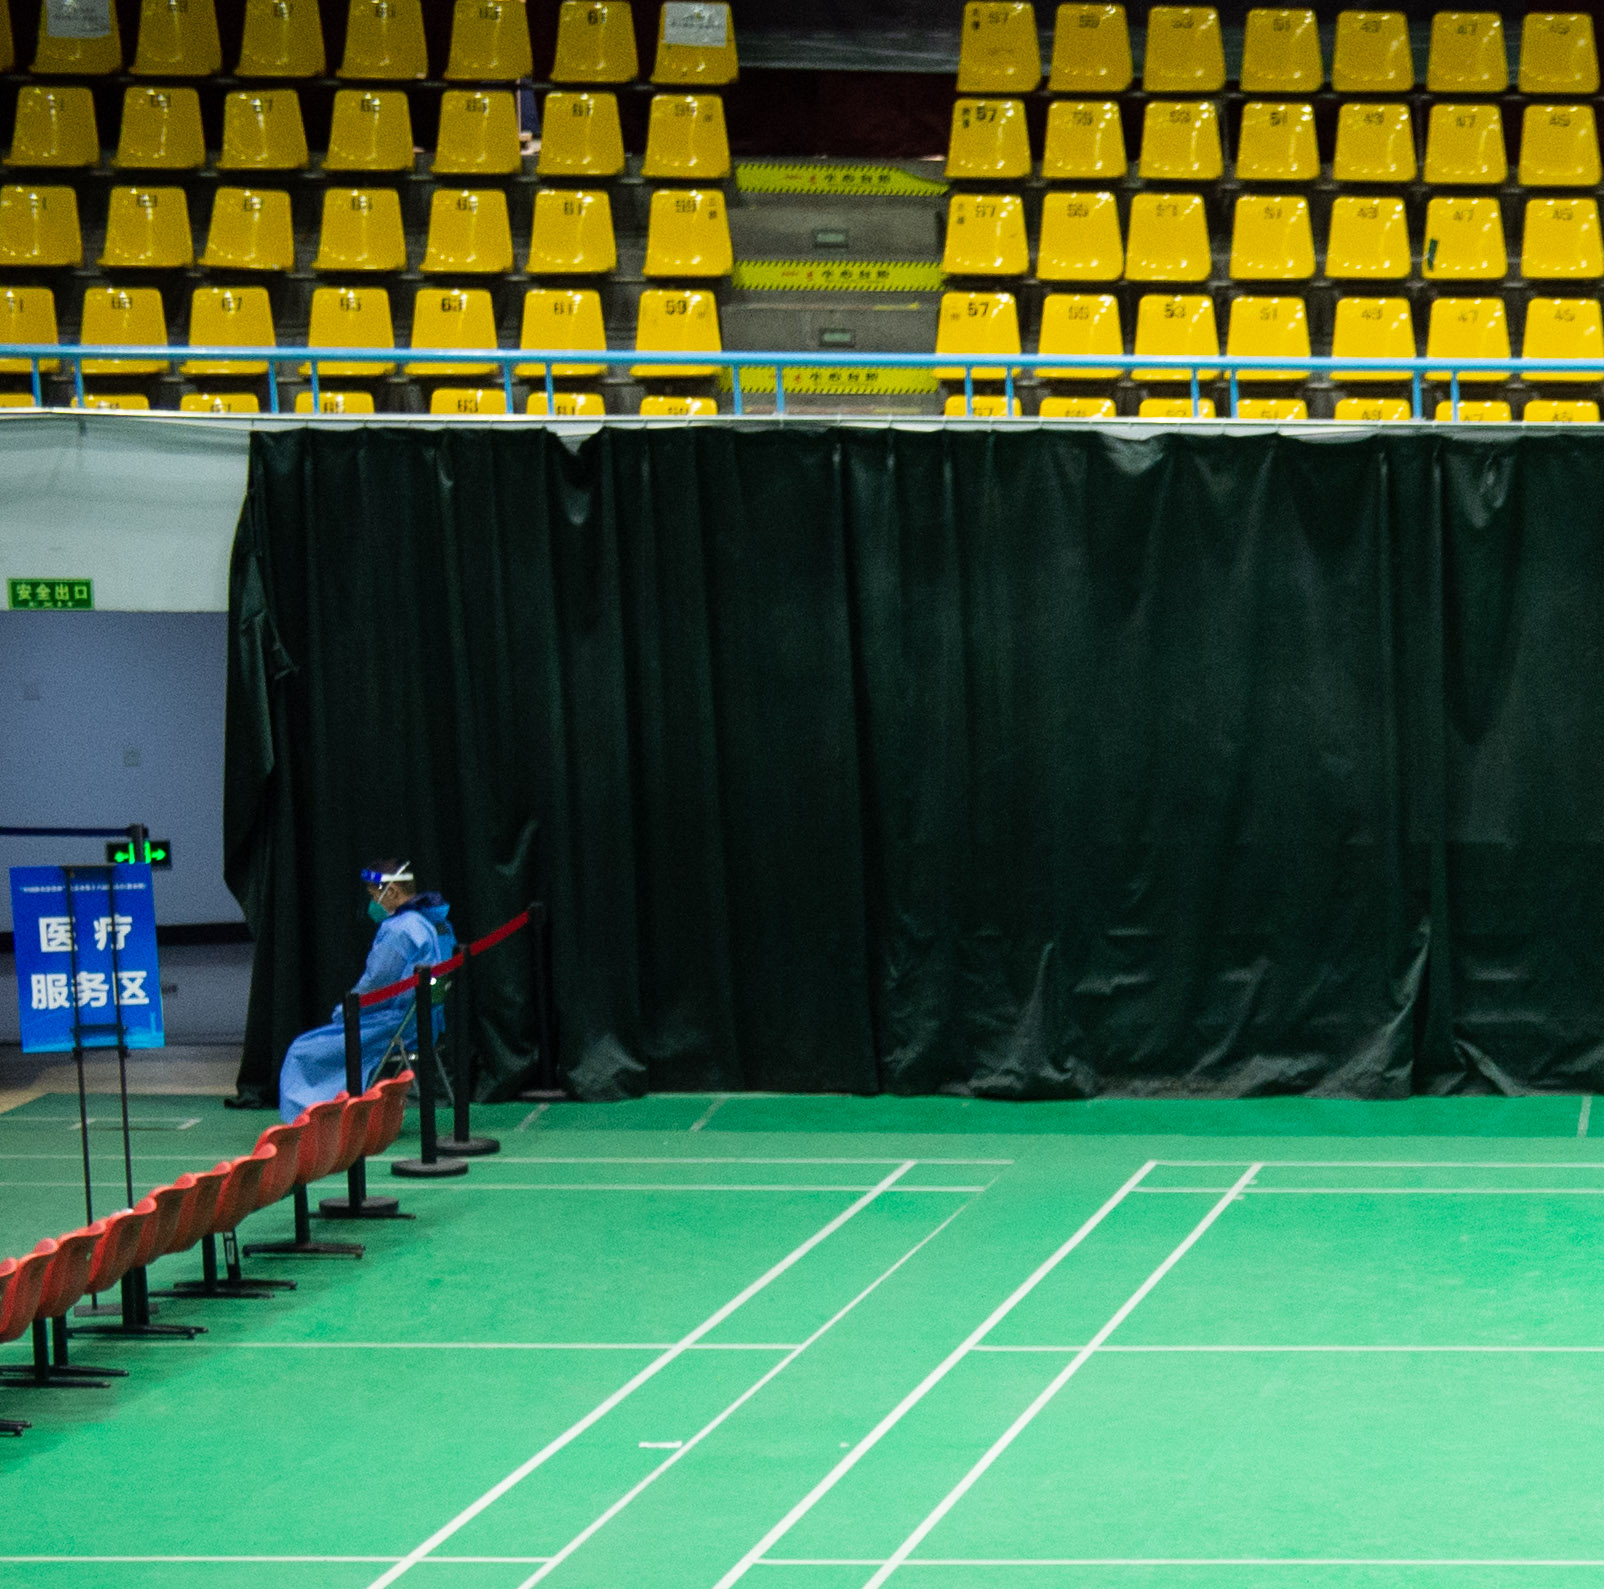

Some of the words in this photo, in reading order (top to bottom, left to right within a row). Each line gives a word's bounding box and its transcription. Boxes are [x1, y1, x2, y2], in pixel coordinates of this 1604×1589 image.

[968, 302, 989, 316] 57
[16, 583, 88, 600] 安全出口
[38, 913, 133, 952] 医疗
[30, 970, 150, 1010] 服务区
